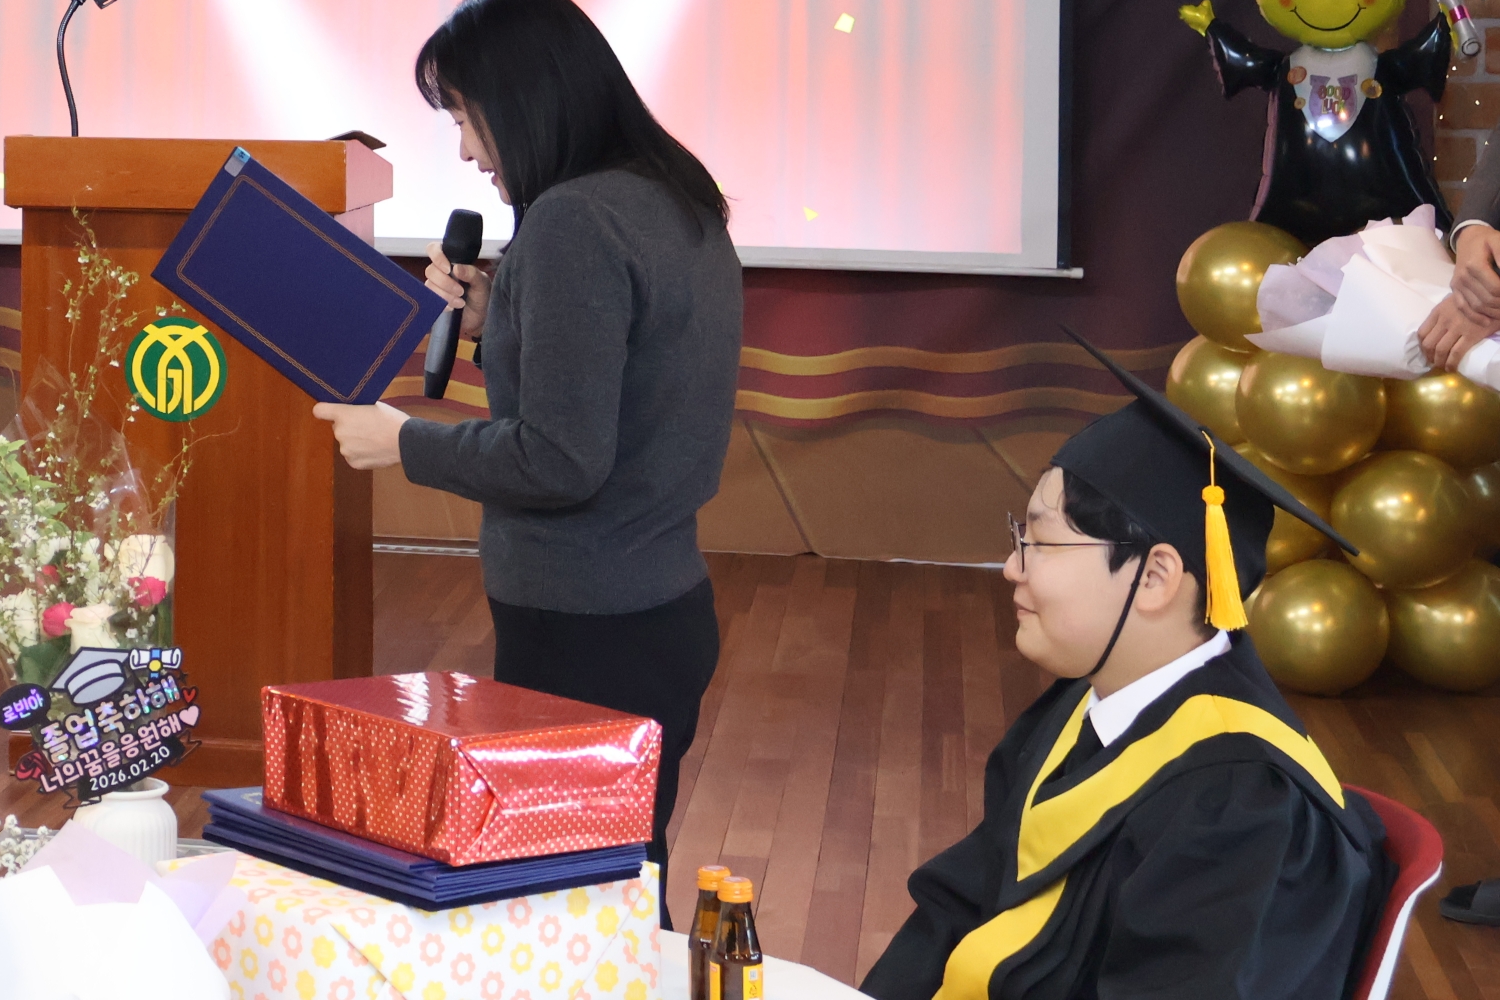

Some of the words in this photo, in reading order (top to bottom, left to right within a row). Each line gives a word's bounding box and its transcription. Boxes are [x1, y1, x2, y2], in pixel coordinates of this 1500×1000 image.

[2, 693, 44, 723] 로빈아
[40, 675, 180, 763] 졸업축하해
[40, 713, 182, 793] 너의꿈을응원해
[89, 745, 170, 791] 2026.02.20
